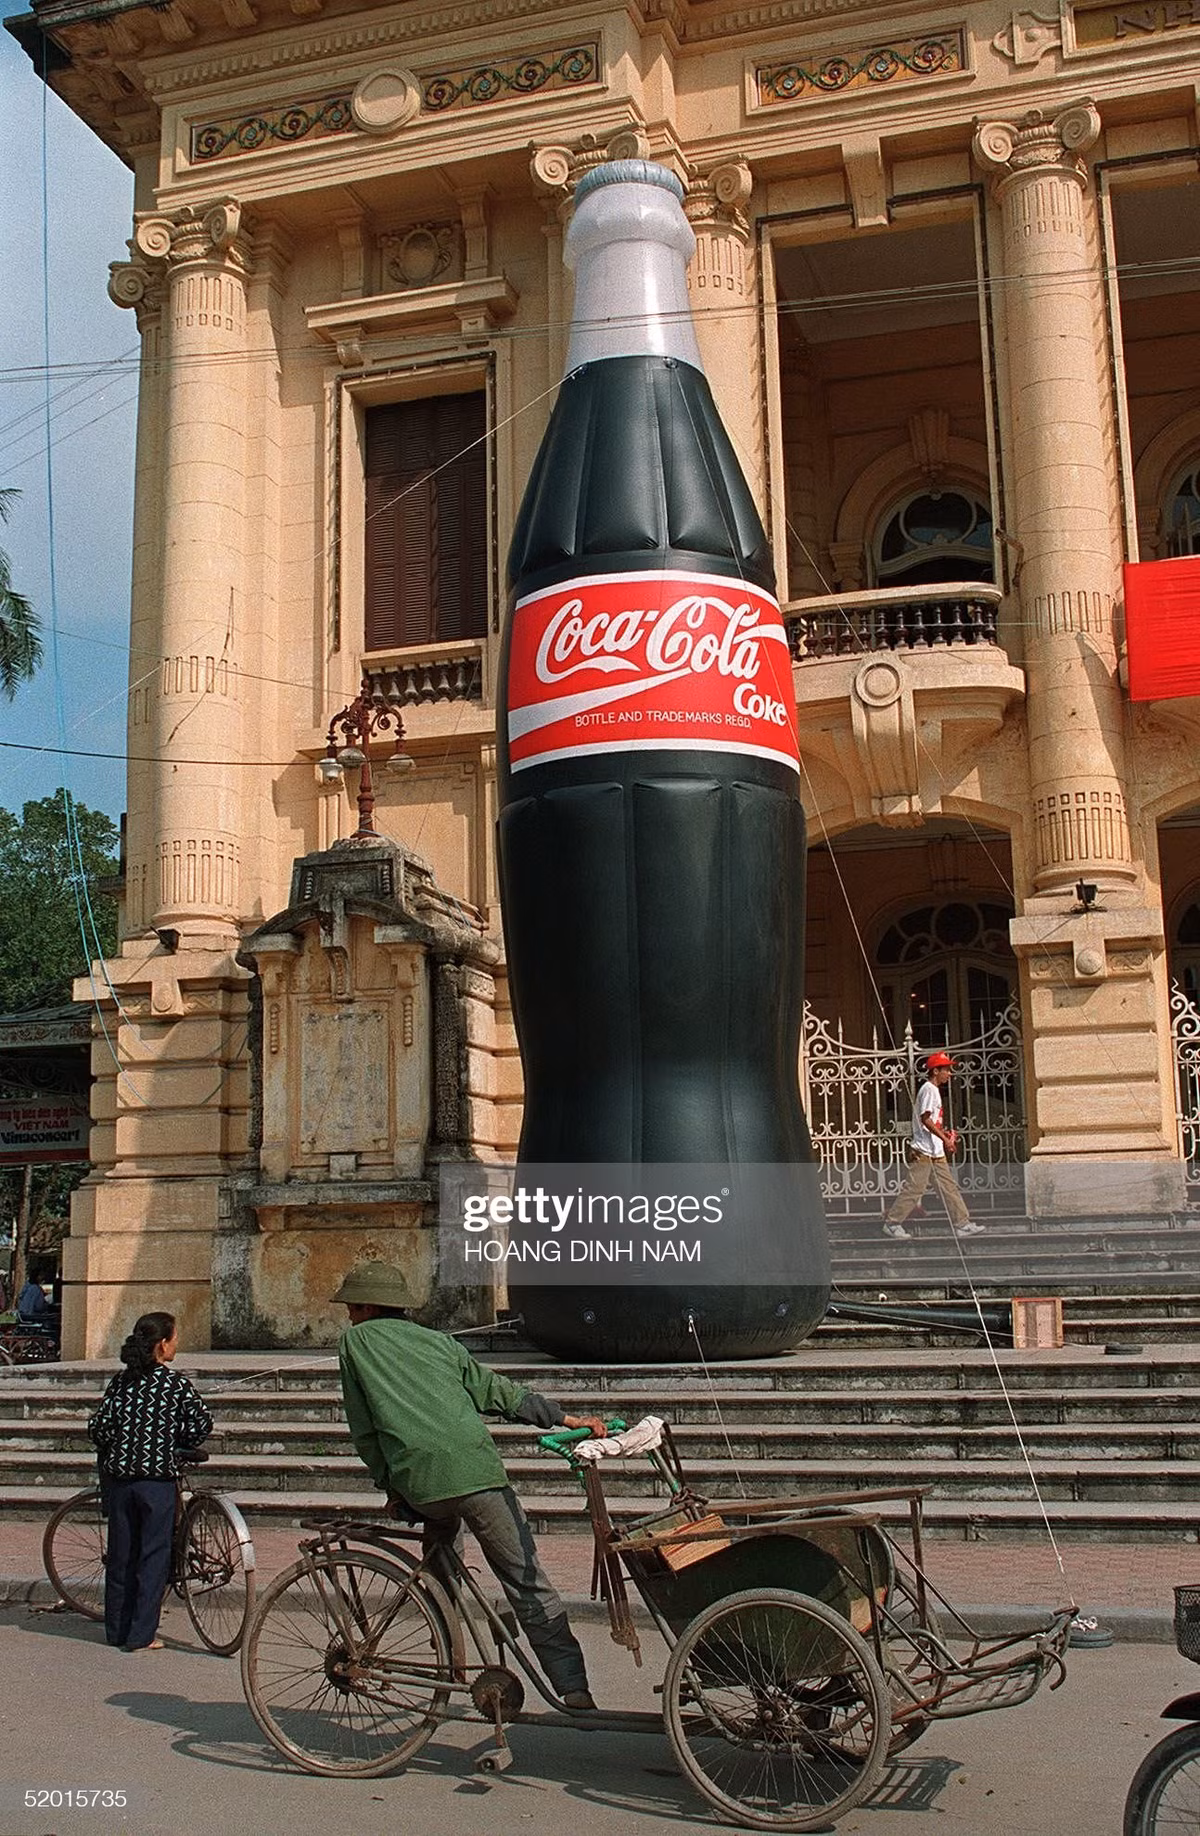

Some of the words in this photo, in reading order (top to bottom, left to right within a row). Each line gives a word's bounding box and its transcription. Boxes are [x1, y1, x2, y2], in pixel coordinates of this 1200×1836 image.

[536, 595, 761, 684] Coca-Cola
[575, 711, 615, 728] BOTTLE
[617, 710, 643, 724] AND
[646, 710, 723, 725] TRADEMARKS
[732, 682, 787, 727] Coke
